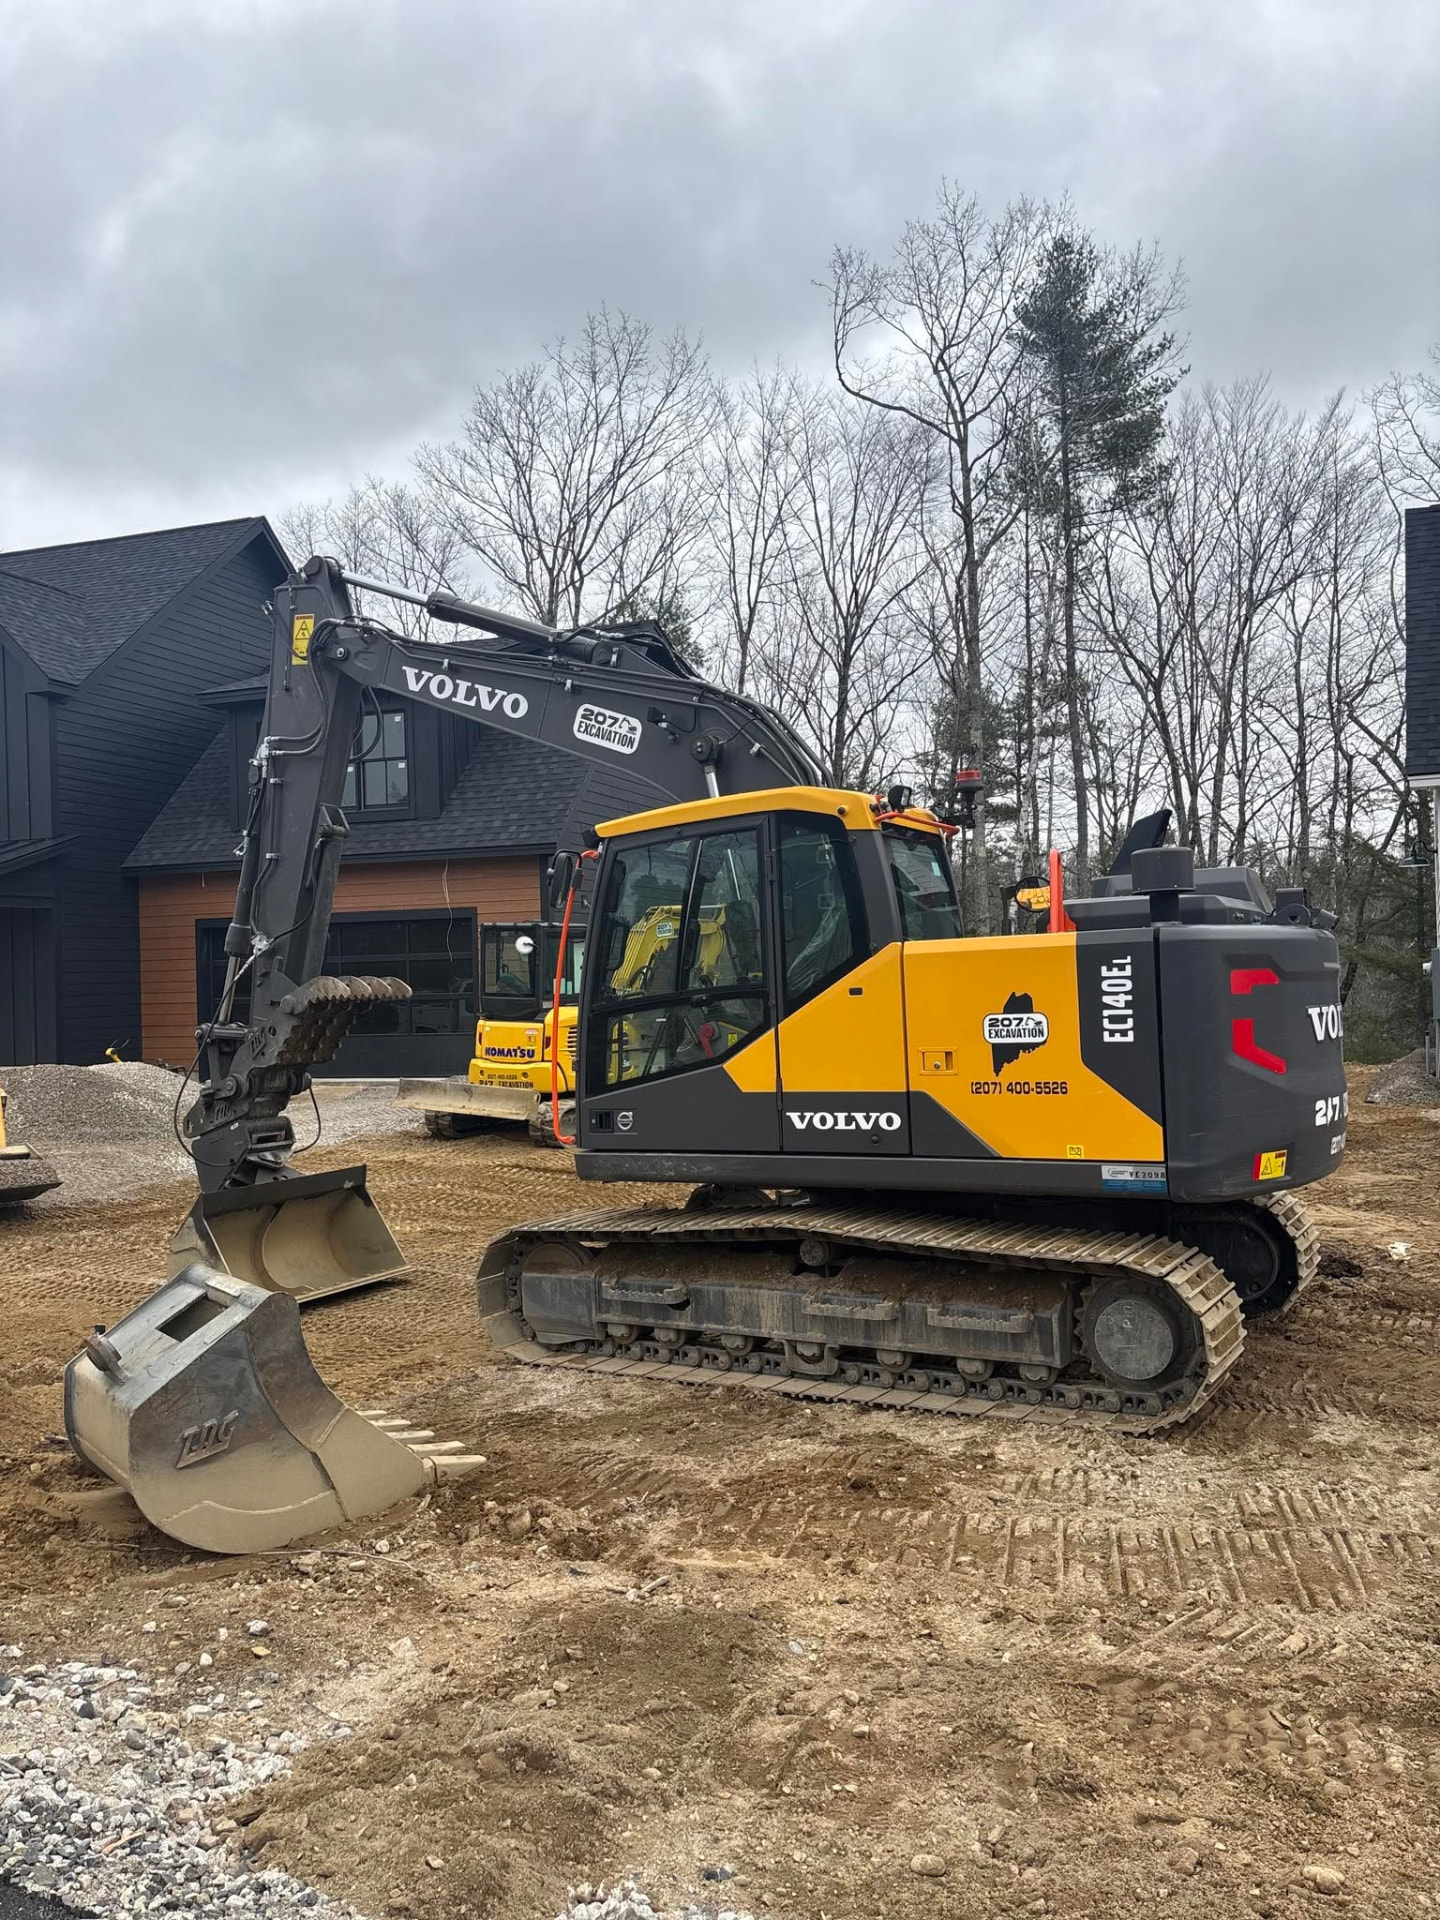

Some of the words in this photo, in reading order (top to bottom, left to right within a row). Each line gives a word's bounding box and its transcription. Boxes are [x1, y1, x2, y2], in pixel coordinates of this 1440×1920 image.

[402, 665, 529, 719] VOLVO
[580, 707, 620, 729] 207
[577, 720, 636, 750] EXCAVATION
[988, 1016, 1024, 1028] 207
[988, 1027, 1044, 1039] EXCAVATION
[484, 1046, 536, 1059] KOMATSU
[498, 1080, 534, 1089] EXCAVATION
[971, 1081, 1002, 1095] (207)
[1006, 1081, 1068, 1095] 400-5526
[786, 1112, 901, 1130] VOLVO
